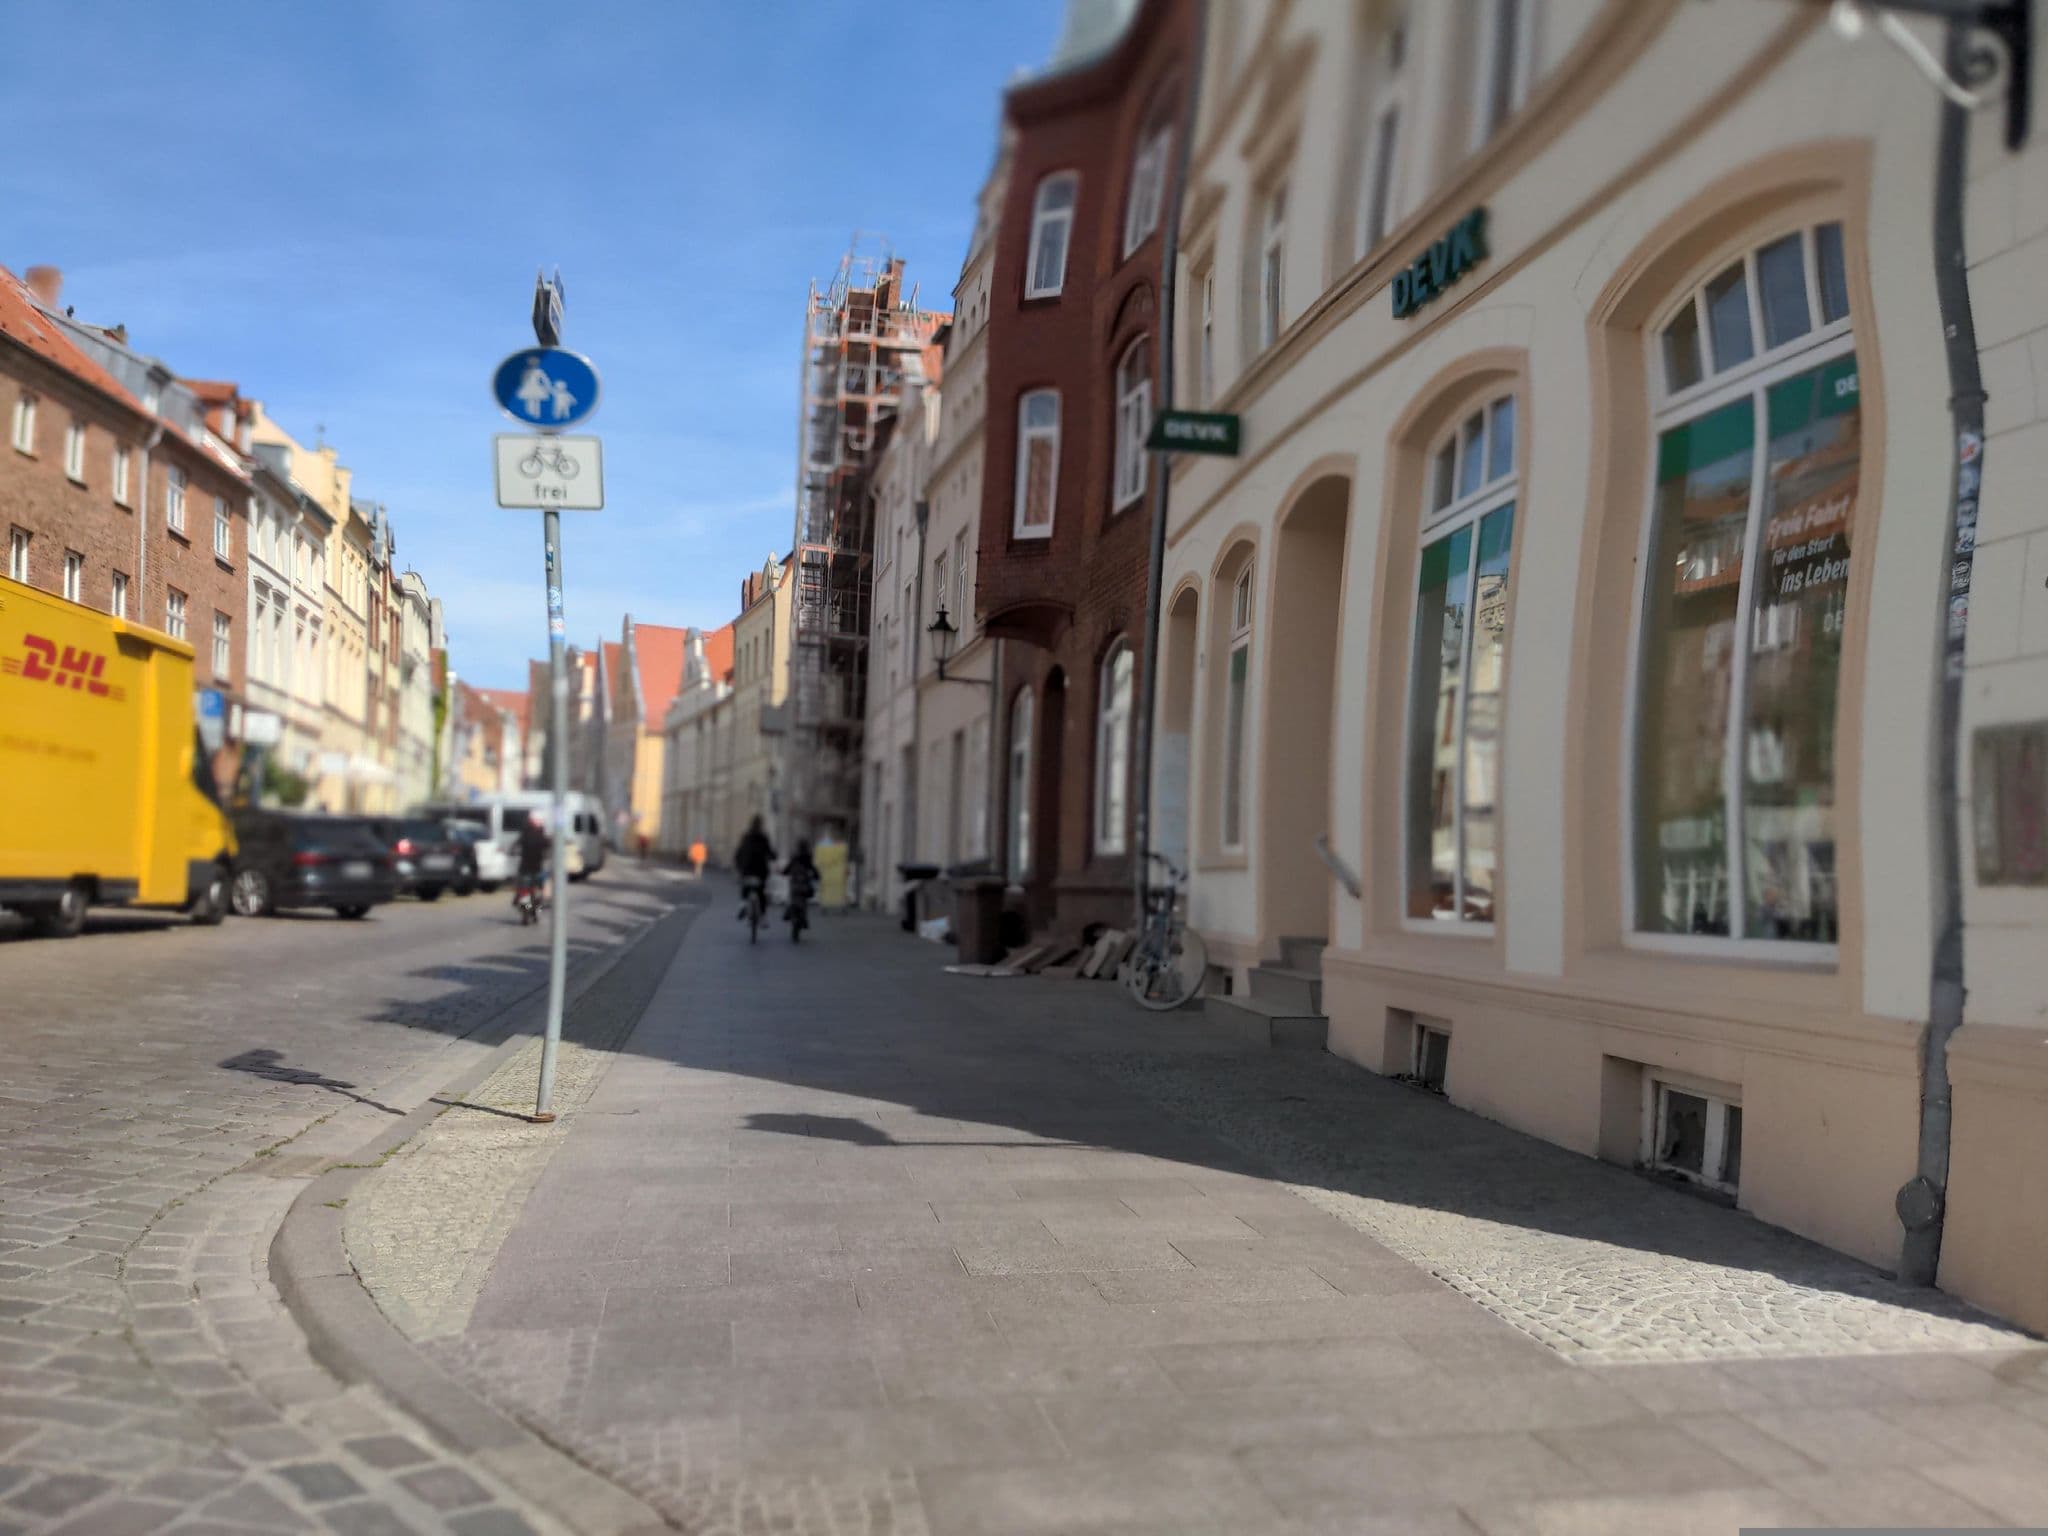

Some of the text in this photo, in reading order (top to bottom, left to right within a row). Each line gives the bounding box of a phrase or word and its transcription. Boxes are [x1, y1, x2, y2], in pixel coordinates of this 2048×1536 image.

[1392, 207, 1488, 319] DEVK
[1164, 420, 1227, 441] DEVK
[534, 482, 568, 499] frei
[1788, 544, 1806, 561] den
[1807, 534, 1834, 556] Start
[1780, 558, 1849, 594] ins Leben
[22, 633, 110, 697] DHL
